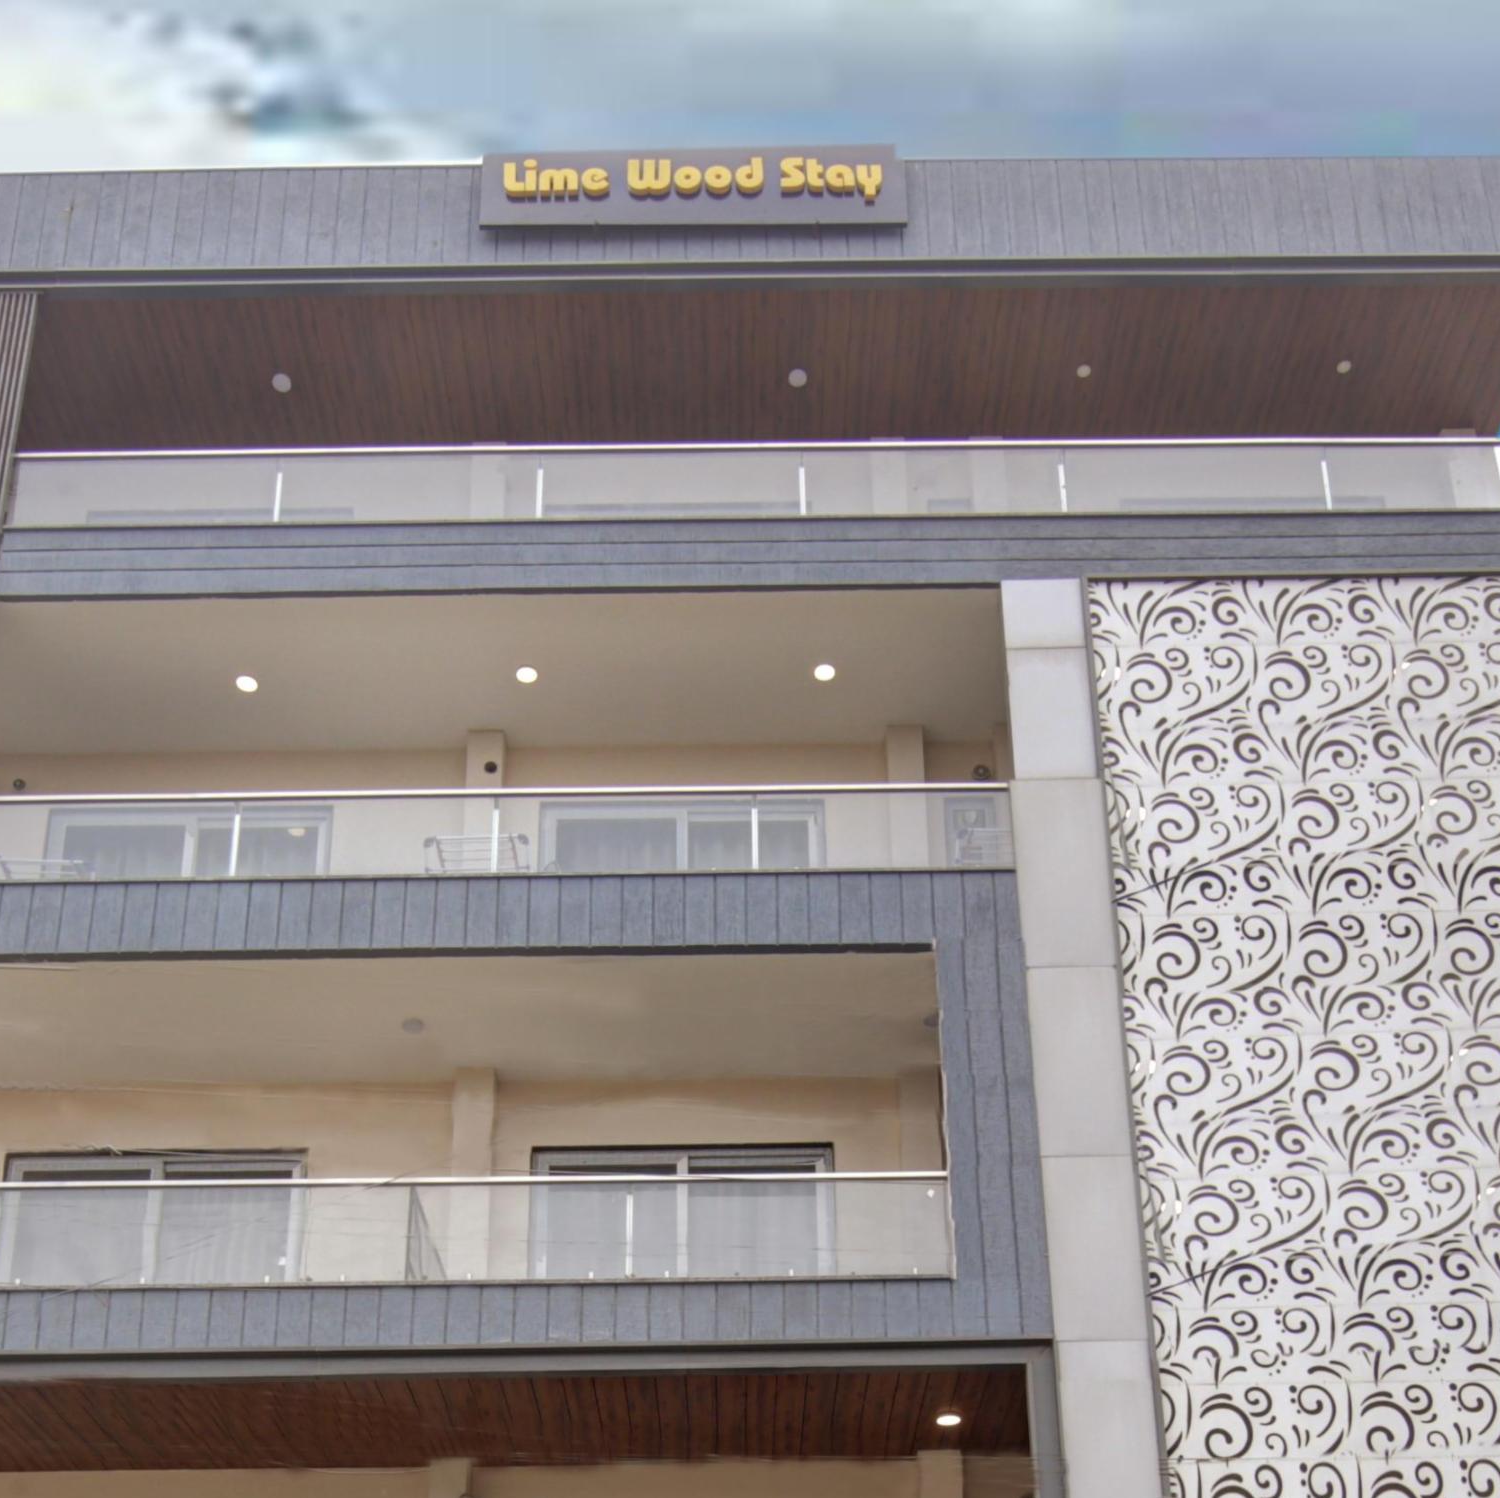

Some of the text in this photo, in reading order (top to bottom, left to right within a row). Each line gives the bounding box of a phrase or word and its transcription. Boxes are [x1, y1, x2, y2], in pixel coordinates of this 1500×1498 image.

[503, 155, 884, 203] Lime Wood Stay
